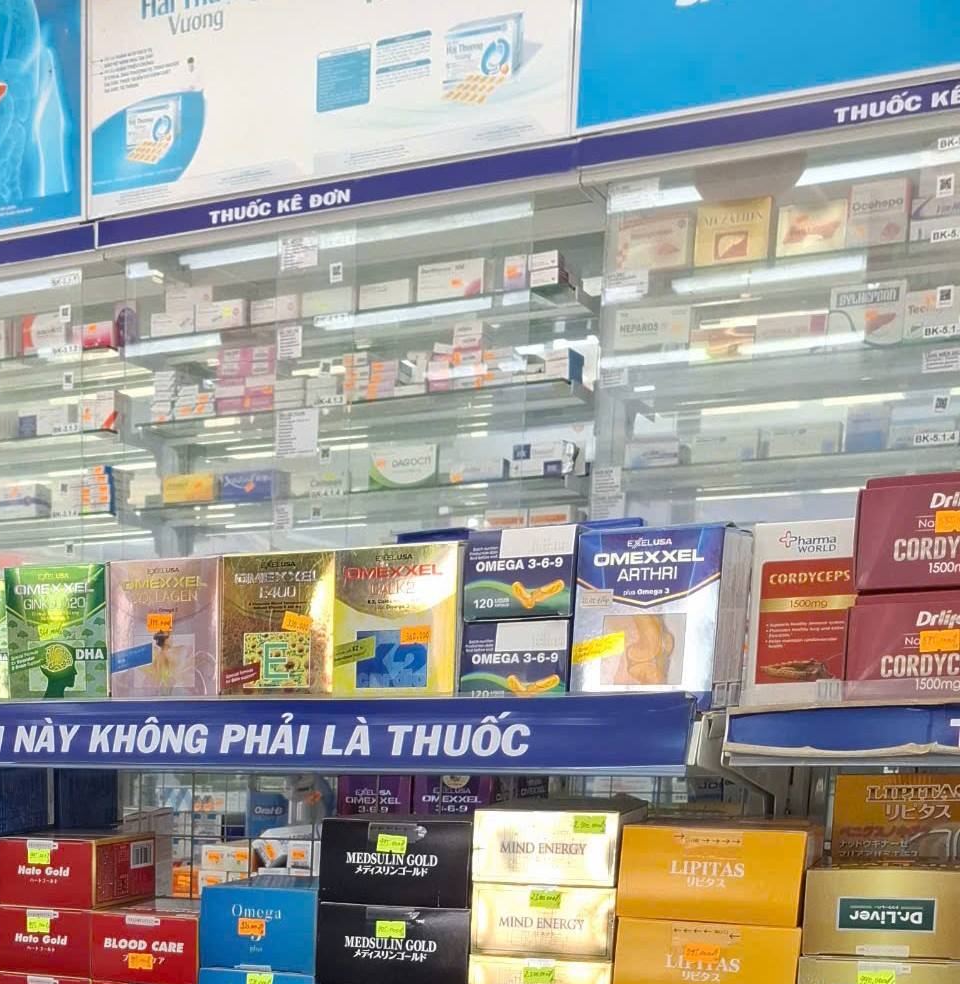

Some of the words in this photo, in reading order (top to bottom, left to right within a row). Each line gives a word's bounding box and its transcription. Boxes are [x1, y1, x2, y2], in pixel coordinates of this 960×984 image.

[834, 91, 921, 122] THUỐC
[210, 195, 271, 225] THUỐC
[277, 193, 303, 214] KÊ
[310, 189, 351, 209] ĐƠN
[799, 544, 836, 552] WORLD
[594, 549, 704, 566] OMEXXEL
[476, 559, 524, 572] OMEGA
[528, 558, 563, 568] 3-6-9
[344, 564, 443, 582] OMEXXEL
[618, 566, 677, 582] ARTHRI
[769, 570, 850, 585] CORDYCEPS
[15, 583, 94, 595] OMEXXEL
[122, 576, 207, 591] OMEXXEL
[474, 599, 493, 608] 120
[790, 600, 828, 609] 1500mg
[76, 650, 103, 659] DHA
[472, 653, 519, 664] OMEGA
[523, 652, 558, 662] 3-6-9
[14, 715, 81, 753] NÀY
[89, 717, 207, 755] KHÔNG
[220, 713, 309, 755] PHẢI
[324, 717, 371, 756] LÀ
[388, 712, 530, 757] THUỐC
[500, 842, 535, 853] MIND
[539, 843, 586, 856] ENERGY
[346, 852, 402, 866] MEDSULIN
[406, 854, 438, 868] GOLD
[18, 865, 42, 877] Hato
[46, 866, 69, 878] Gold
[355, 865, 428, 877] メディスリンゴールド
[670, 859, 744, 877] LIPITAS
[687, 877, 725, 888] リピタス
[231, 904, 281, 921] Omega
[850, 910, 922, 924] Dr.Liver
[499, 916, 534, 928] MIND
[539, 918, 585, 931] ENERGY
[15, 933, 38, 944] Hato
[43, 935, 68, 946] Gold
[104, 938, 148, 950] BLOOD
[152, 941, 184, 953] CARE
[345, 935, 401, 951] MEDSULIN
[404, 939, 437, 953] GOLD
[353, 949, 427, 962] メディスリンゴールド
[682, 971, 720, 982] リピタス
